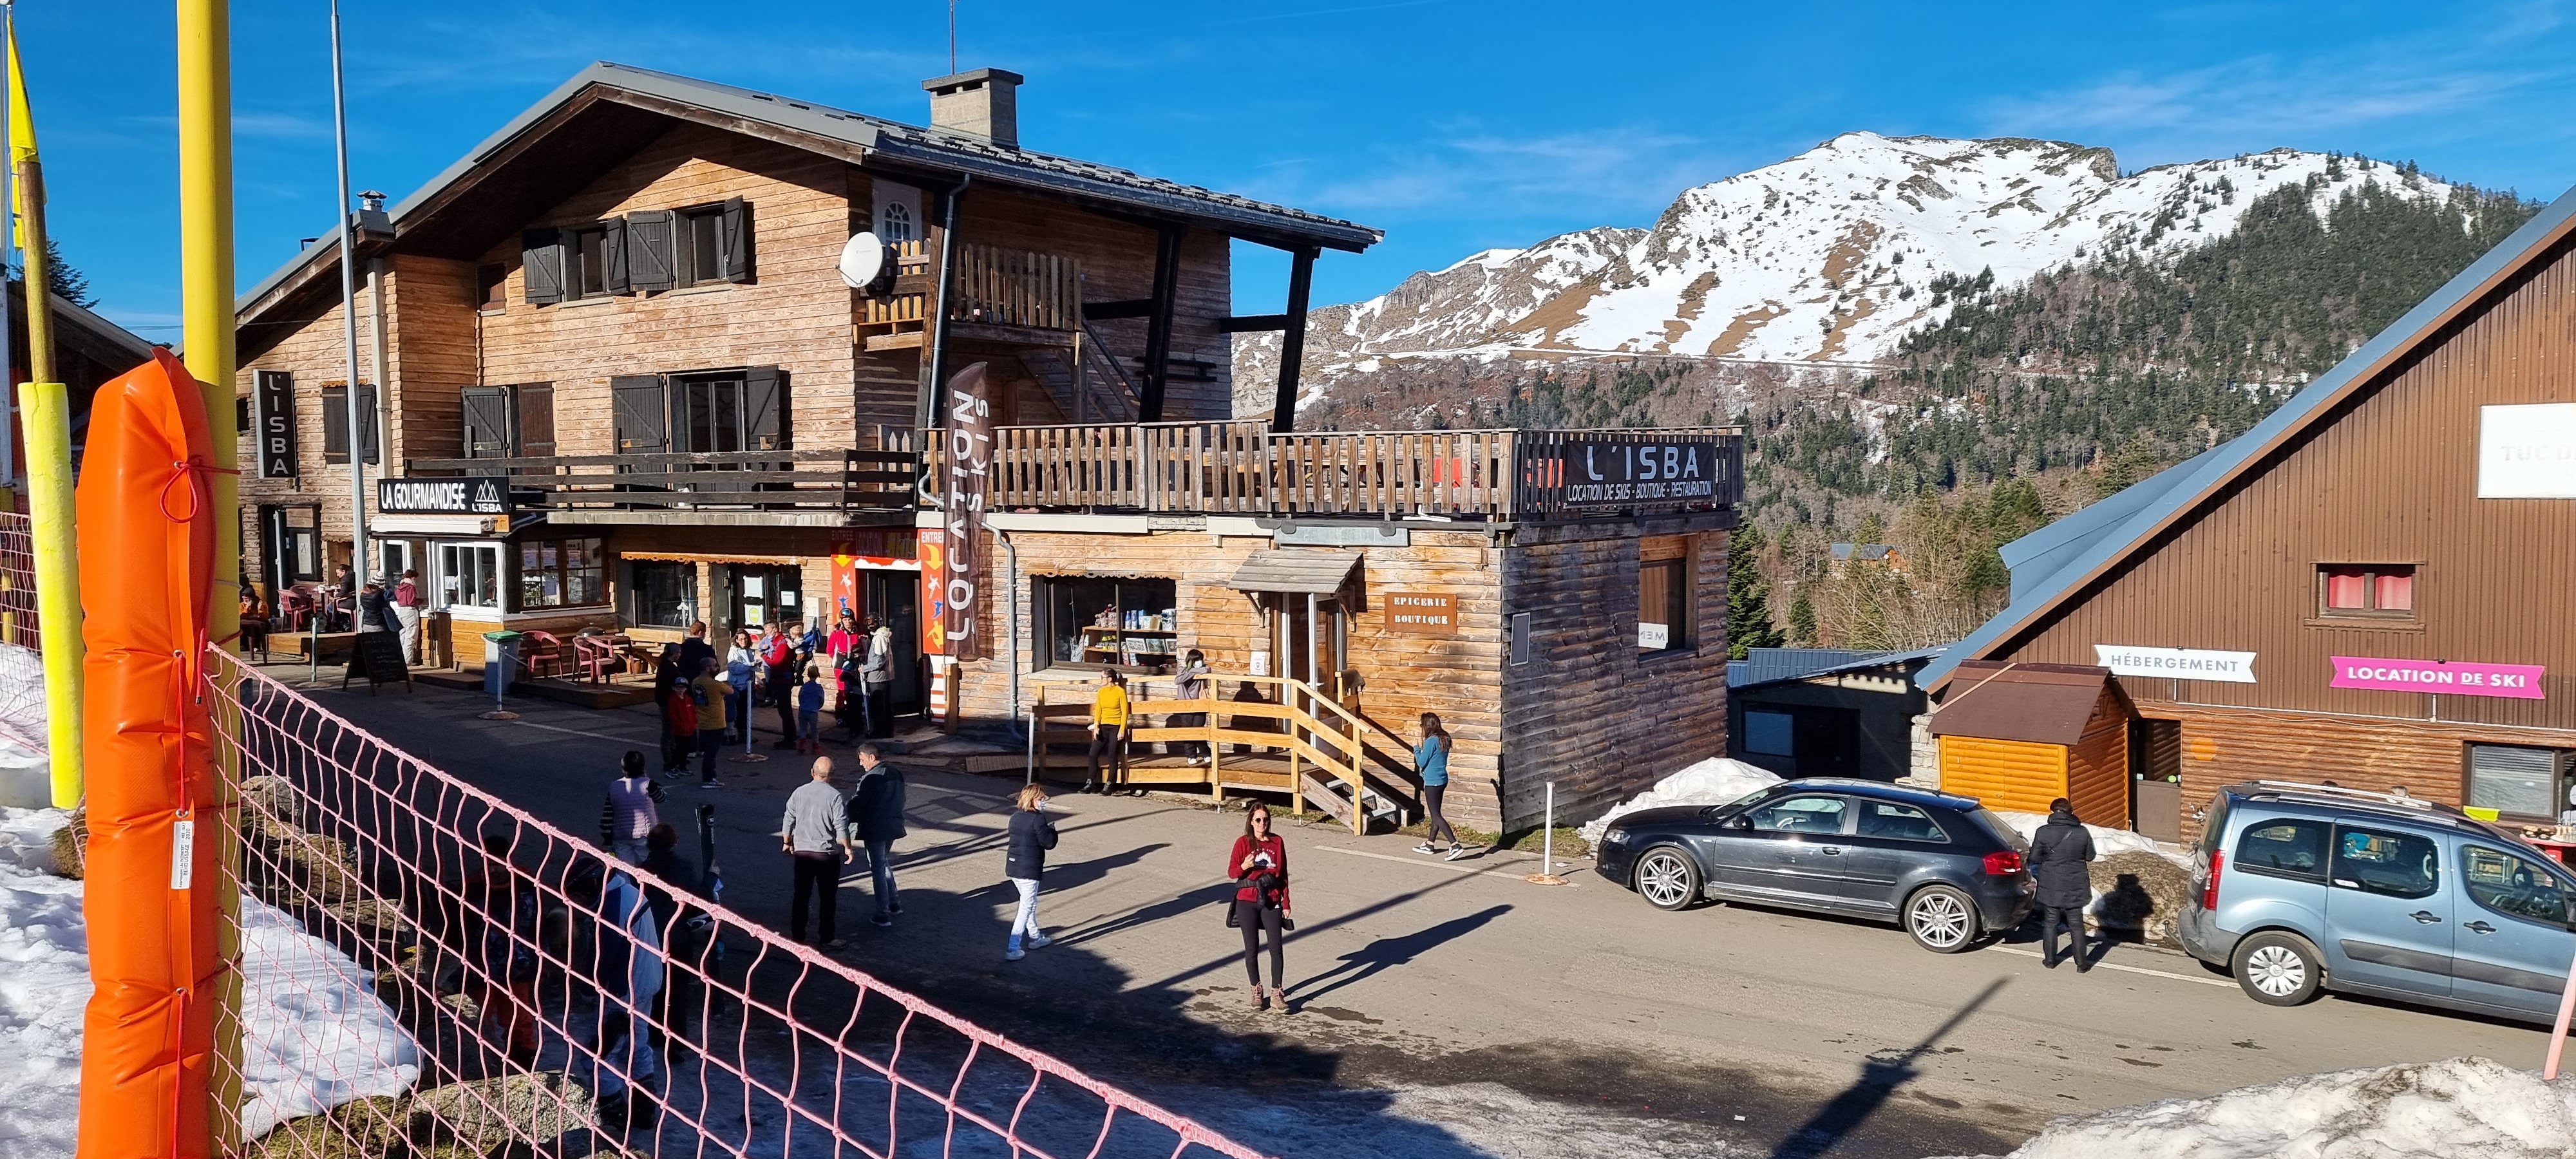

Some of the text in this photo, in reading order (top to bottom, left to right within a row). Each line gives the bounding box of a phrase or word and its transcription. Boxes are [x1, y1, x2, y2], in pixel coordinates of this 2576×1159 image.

[268, 374, 289, 475] L'ISBA
[966, 398, 990, 512] SKIS
[1587, 446, 1700, 481] L'ISBA
[2501, 444, 2576, 461] TUC D
[381, 483, 466, 510] LA GOURMANDISE
[1567, 480, 1712, 502] LOCATION DE SKIS BOUTIQUE RESTAURATION
[471, 503, 503, 513] L'ISBA
[1394, 597, 1447, 607] EPICERIE
[1394, 615, 1448, 625] BOUTIQUE
[2111, 652, 2239, 672] HÉBERGEMENT
[2347, 666, 2525, 688] LOCATION DE SKI
